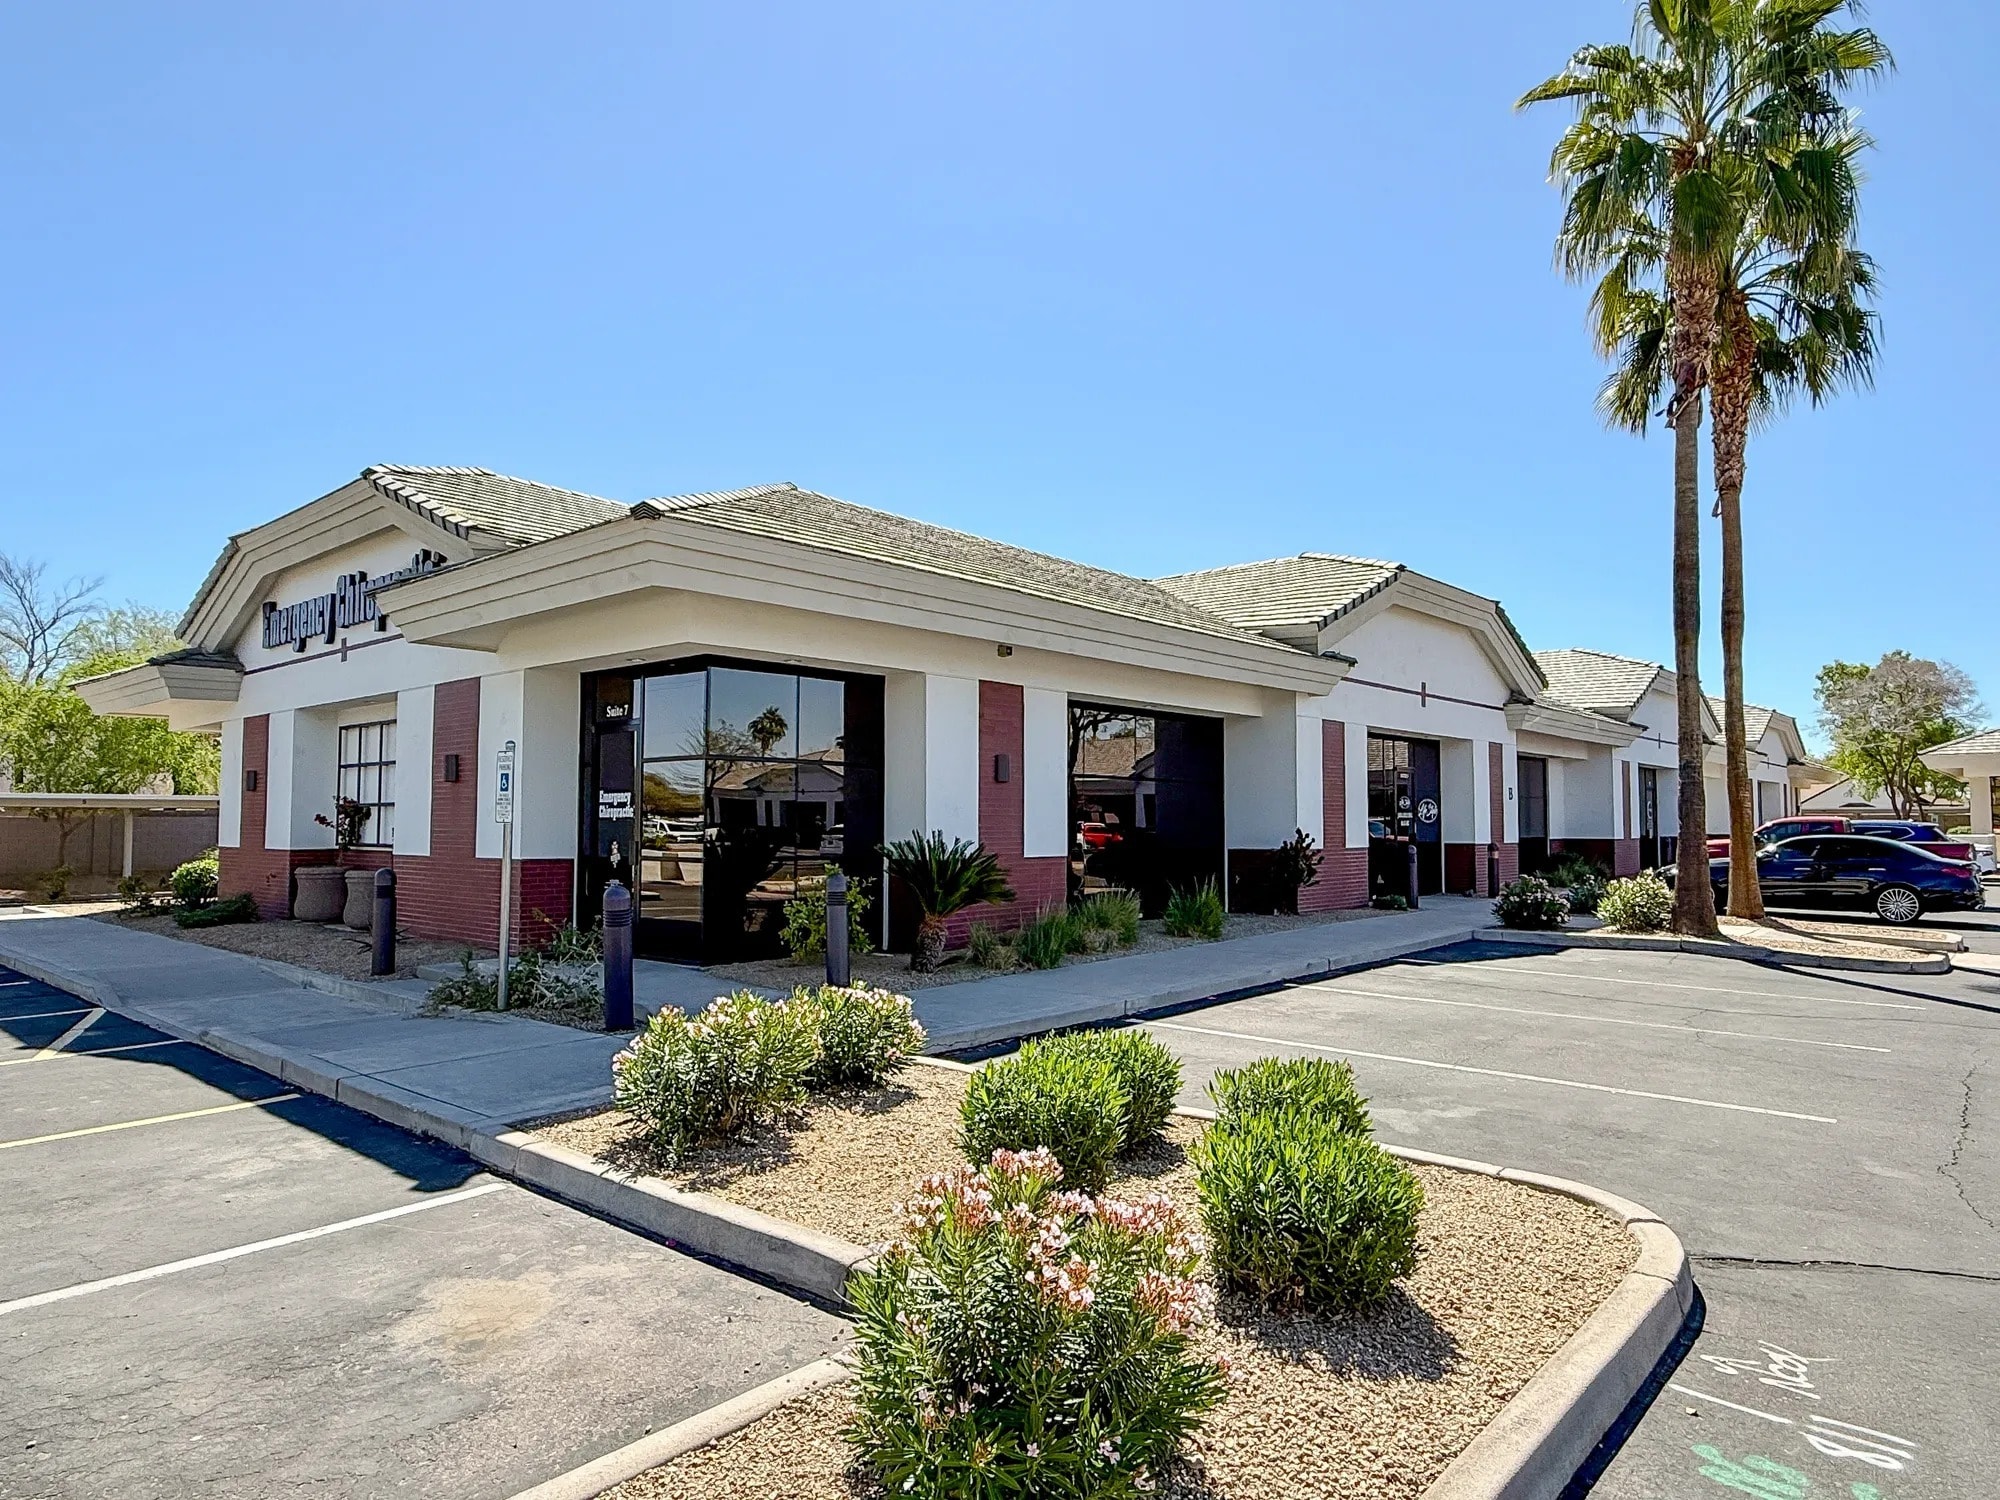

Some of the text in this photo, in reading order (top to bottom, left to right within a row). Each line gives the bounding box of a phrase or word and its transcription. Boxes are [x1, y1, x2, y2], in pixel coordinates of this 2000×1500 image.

[262, 593, 336, 653] Emergency
[606, 704, 629, 717] Suite 7
[599, 790, 631, 806] Emergency
[1508, 787, 1514, 800] B
